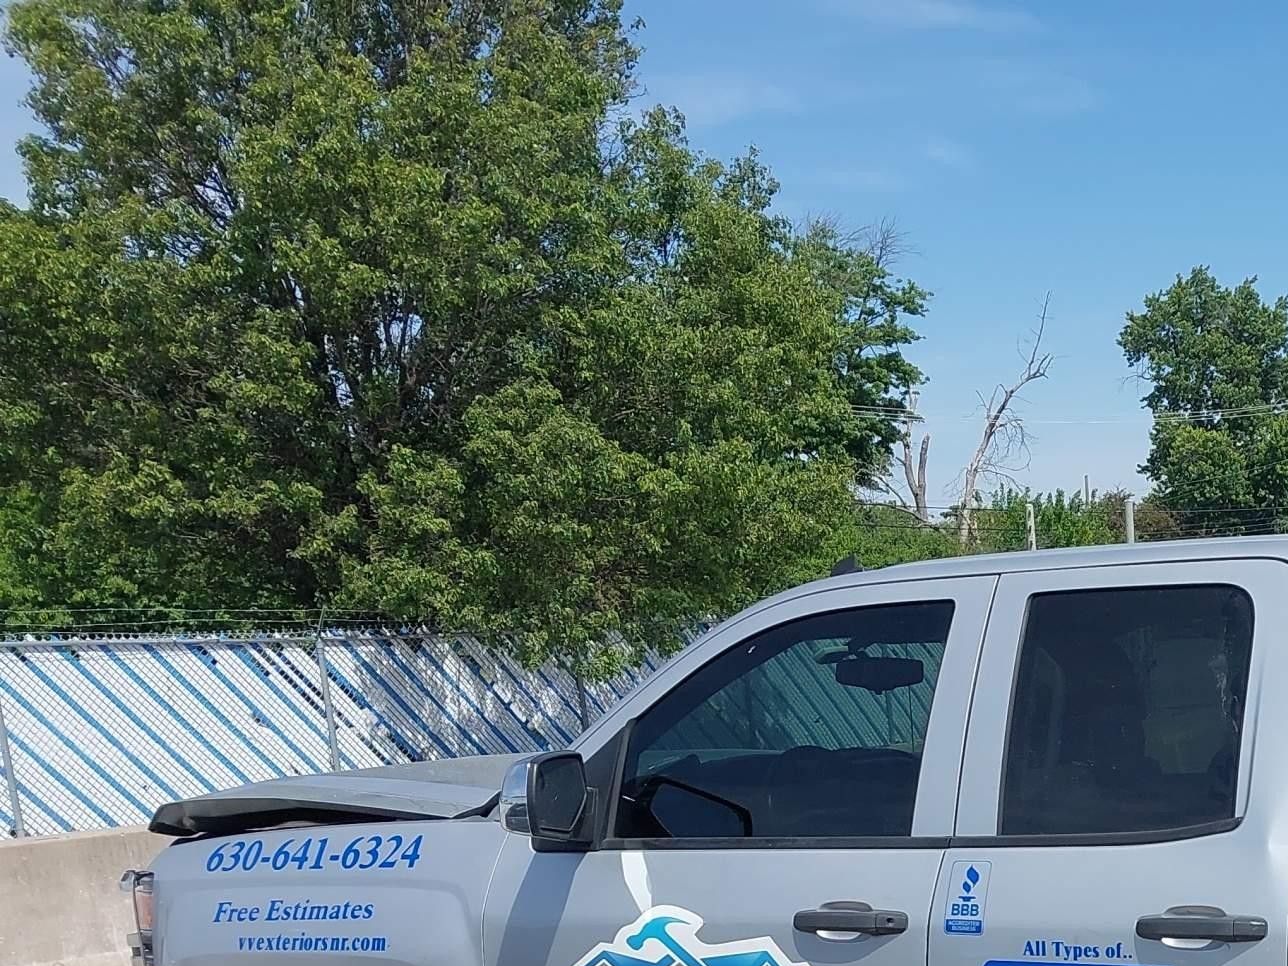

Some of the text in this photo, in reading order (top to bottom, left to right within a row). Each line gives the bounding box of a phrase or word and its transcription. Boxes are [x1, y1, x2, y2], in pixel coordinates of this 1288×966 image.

[206, 835, 424, 873] 630-641-6324
[212, 899, 375, 923] Free Estimates
[951, 903, 980, 917] BBB
[238, 931, 387, 952] vvexteriorsnr.com
[1023, 940, 1134, 960] All Types of..
